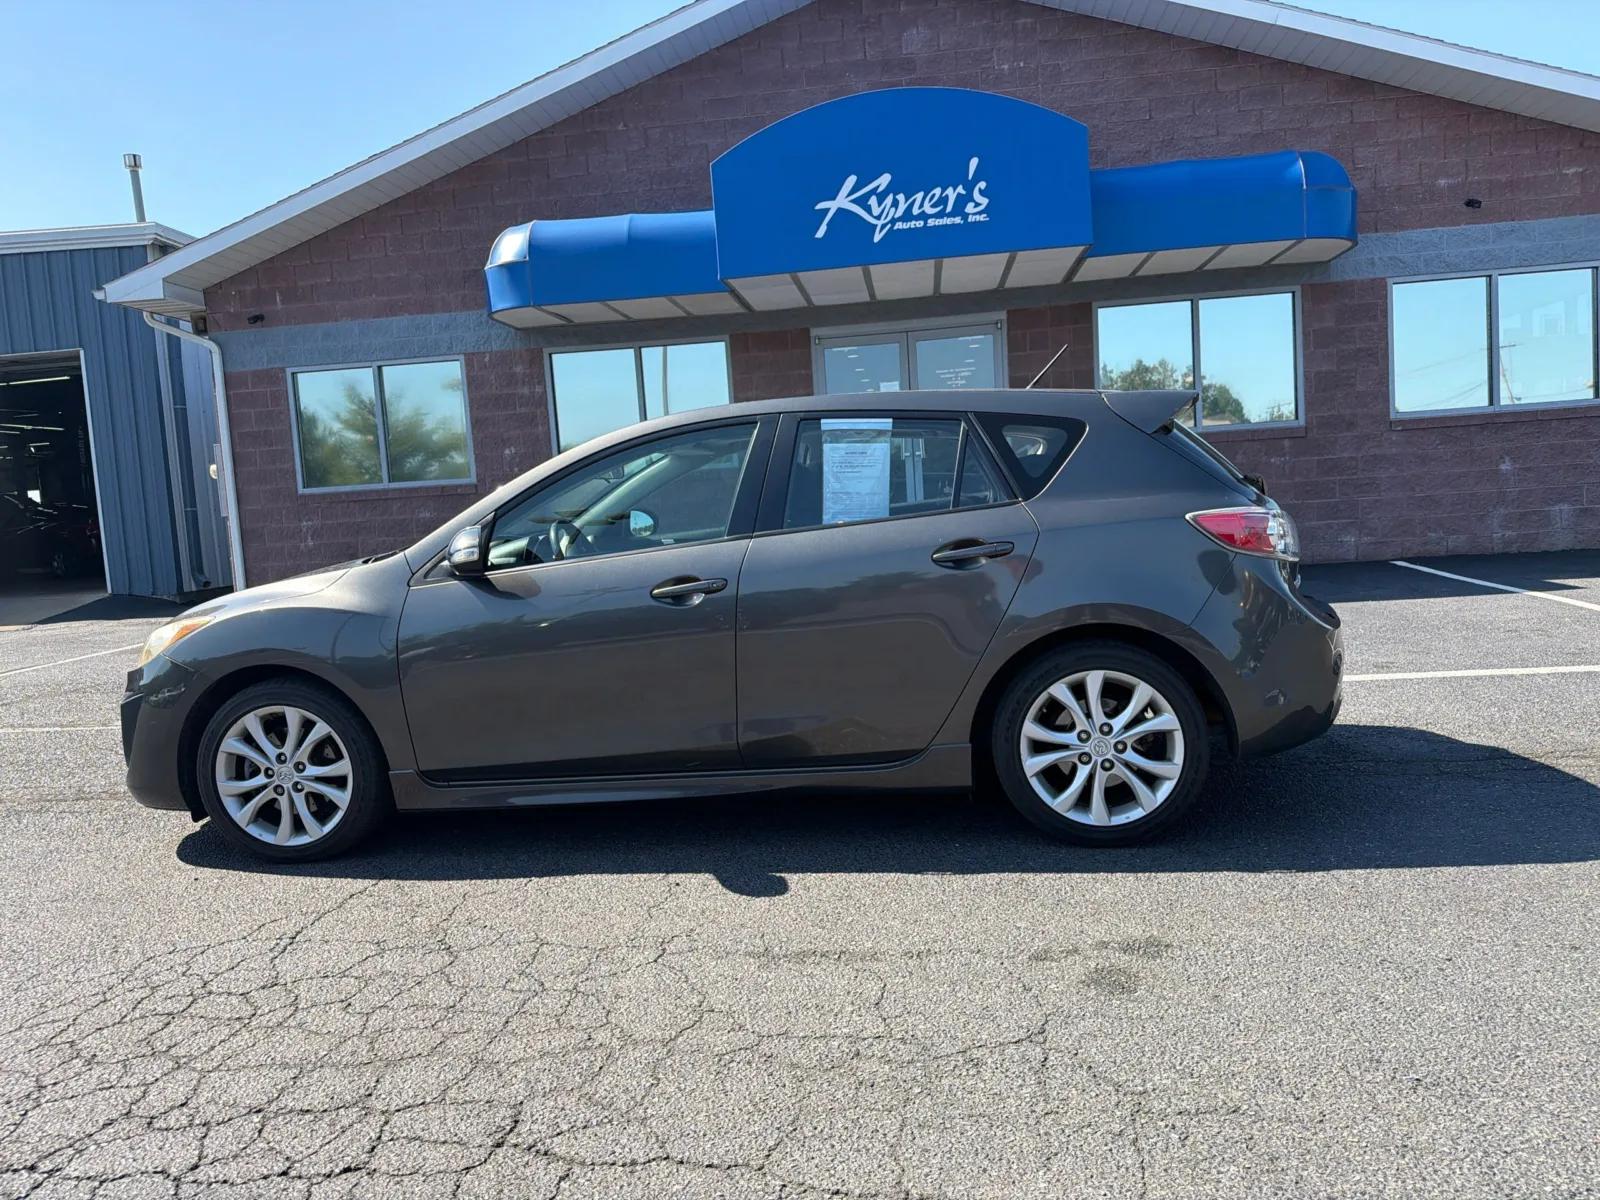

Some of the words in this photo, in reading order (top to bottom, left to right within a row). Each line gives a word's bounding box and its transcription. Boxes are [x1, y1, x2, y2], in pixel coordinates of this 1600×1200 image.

[814, 156, 990, 243] Kyner's
[893, 220, 924, 231] Auto
[926, 216, 964, 227] Sales,
[968, 213, 990, 222] Inc.
